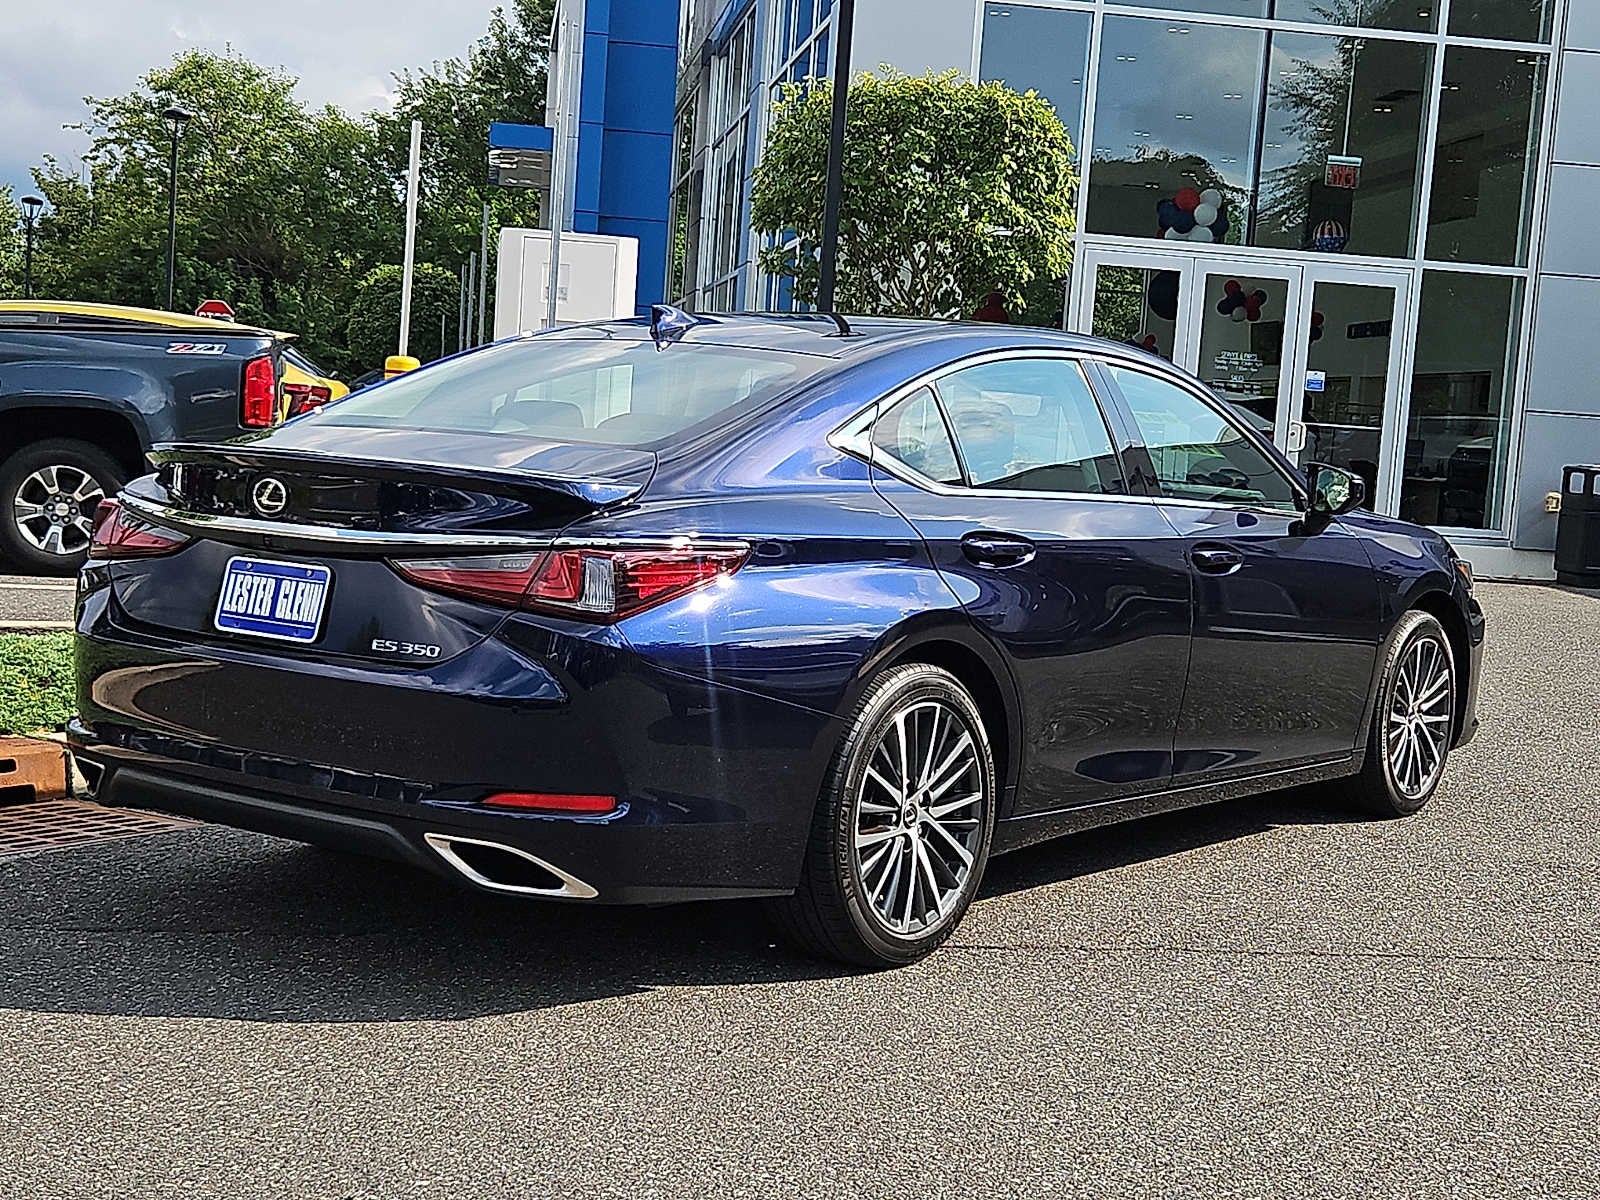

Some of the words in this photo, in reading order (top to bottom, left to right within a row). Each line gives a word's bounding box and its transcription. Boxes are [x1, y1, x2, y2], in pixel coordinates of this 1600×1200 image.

[222, 573, 276, 617] LESTER
[275, 579, 324, 623] GLENN
[371, 639, 398, 652] ES
[399, 642, 440, 657] 350
